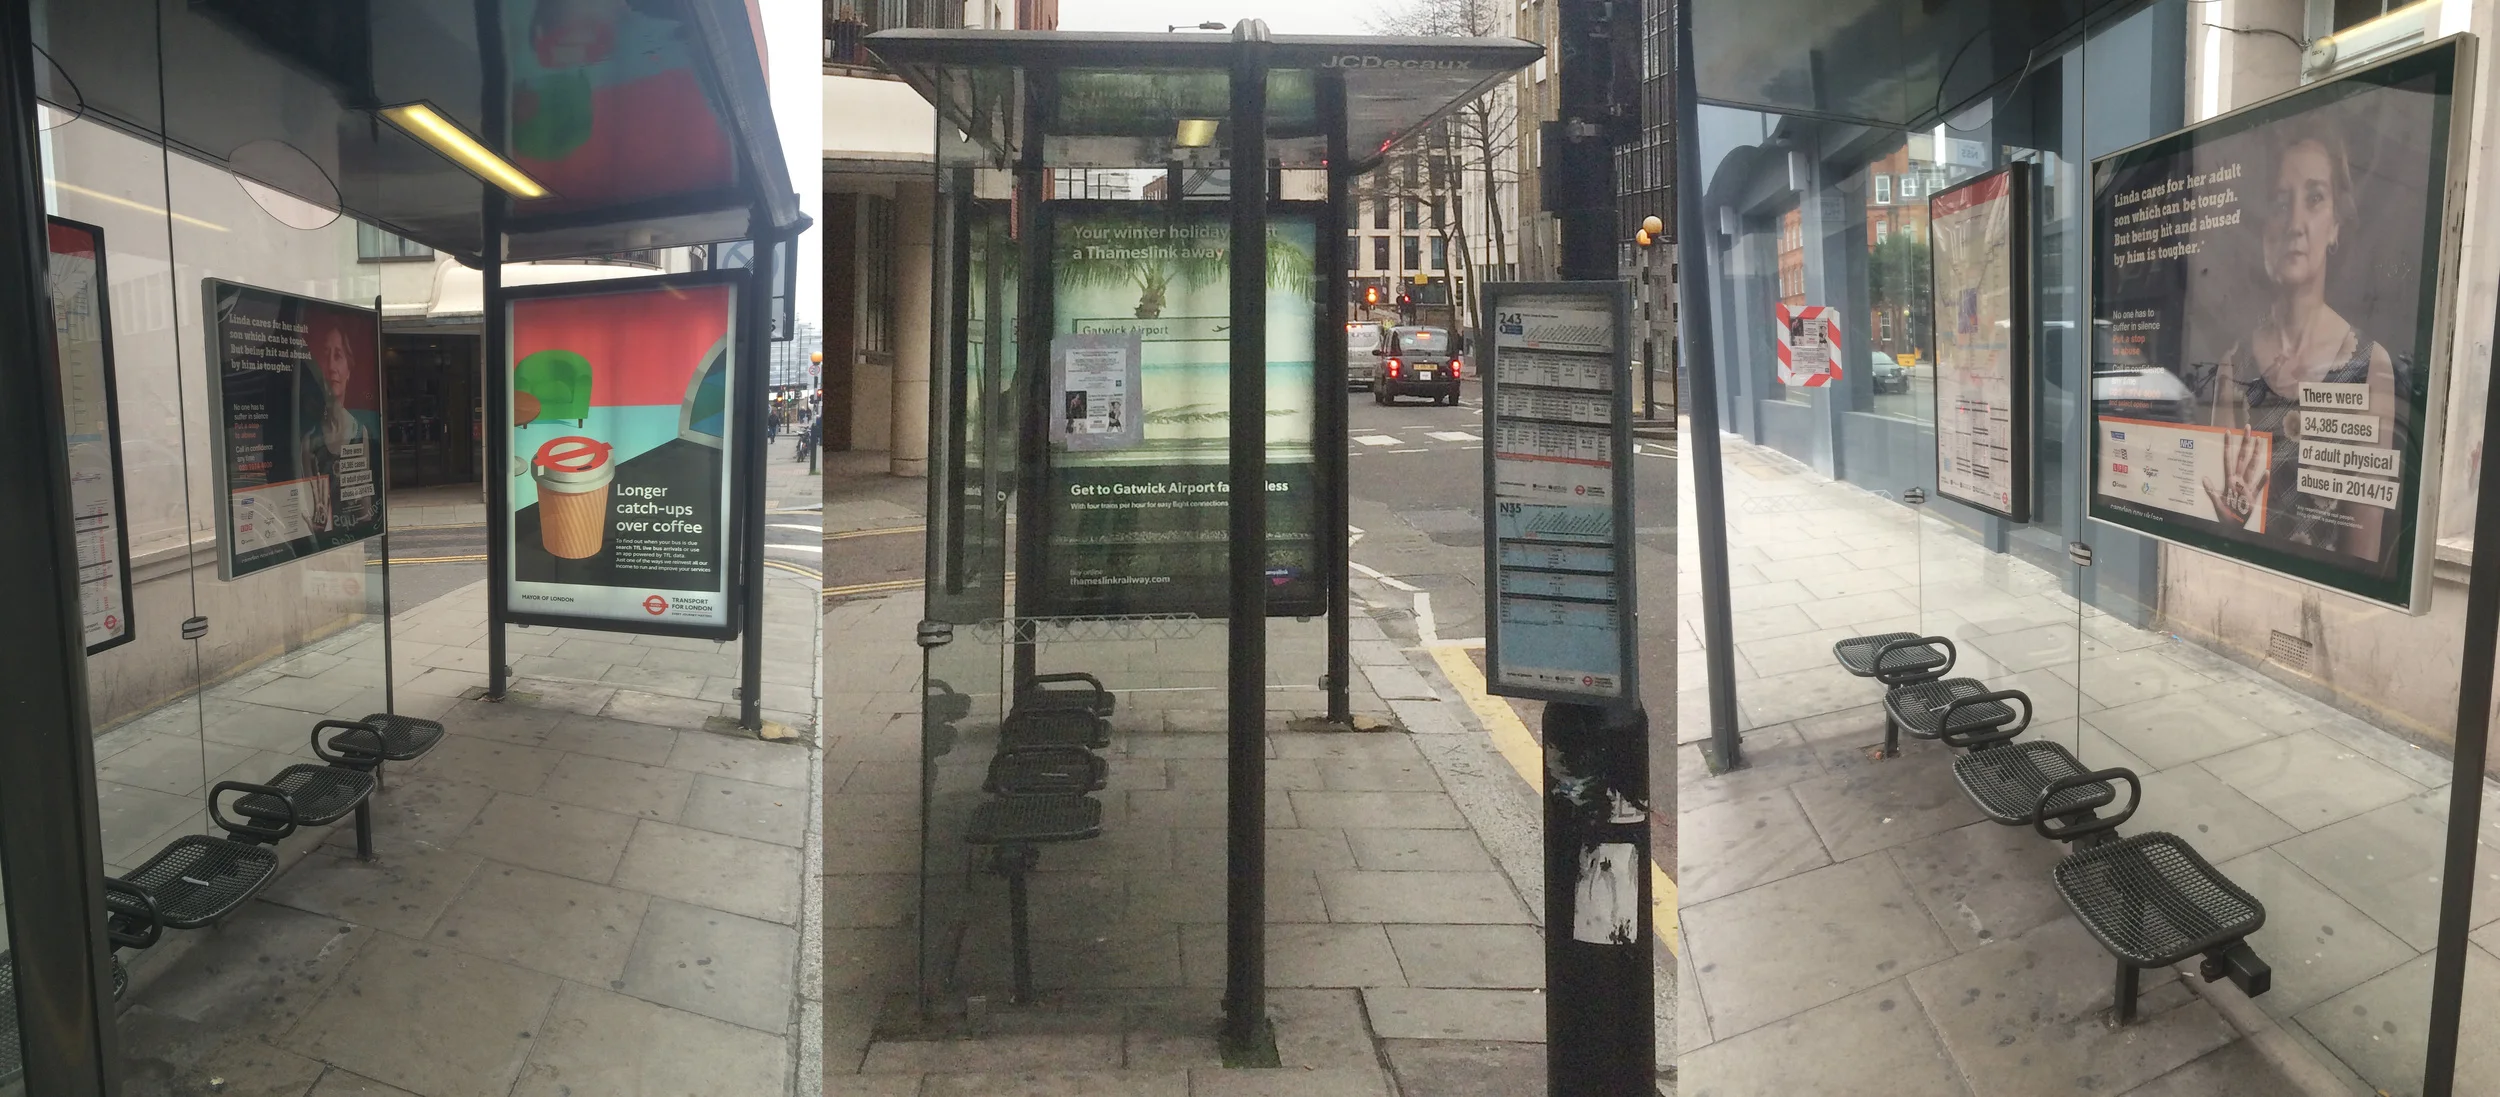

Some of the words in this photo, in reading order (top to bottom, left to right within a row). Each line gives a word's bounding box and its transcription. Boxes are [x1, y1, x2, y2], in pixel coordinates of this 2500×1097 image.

[1321, 55, 1471, 71] JCDecaux
[2114, 190, 2140, 207] Linda
[2141, 184, 2165, 200] cares
[2167, 179, 2185, 193] for
[2187, 174, 2206, 189] her
[2208, 163, 2241, 184] adult
[2114, 216, 2130, 227] son
[2132, 205, 2161, 223] which
[2162, 202, 2180, 216] can
[2183, 198, 2196, 212] be
[2198, 188, 2238, 208] tough.
[1073, 226, 1110, 241] Your
[1114, 225, 1166, 239] winter
[2114, 233, 2130, 246] But
[2132, 228, 2159, 243] being
[2160, 223, 2173, 238] hit
[2174, 218, 2197, 235] and
[2200, 209, 2241, 231] abused
[1072, 250, 1083, 260] a
[1086, 246, 1178, 260] Thameslink
[1181, 248, 1225, 261] away
[2114, 254, 2125, 268] by
[2126, 250, 2145, 264] him
[2147, 247, 2156, 261] is
[1500, 312, 1522, 324] 243
[2112, 310, 2121, 319] No
[2123, 311, 2134, 319] one
[2135, 309, 2146, 318] has
[2147, 308, 2155, 317] to
[229, 313, 251, 326] Linda
[252, 318, 272, 328] cares
[272, 319, 281, 329] for
[282, 320, 292, 331] her
[293, 324, 309, 334] adult
[1082, 325, 1127, 335] Gatwick
[1129, 324, 1169, 336] Airport
[2112, 323, 2130, 332] suffer
[2131, 322, 2137, 330] in
[2137, 321, 2160, 330] silence
[229, 331, 243, 340] son
[244, 331, 266, 342] which
[268, 335, 280, 343] can
[281, 335, 288, 344] be
[2112, 335, 2123, 343] Put
[2131, 334, 2146, 344] stop
[230, 344, 244, 354] But
[245, 345, 264, 358] being
[266, 346, 277, 357] hit
[278, 349, 289, 358] and
[290, 350, 312, 360] abused
[2112, 347, 2119, 355] to
[2121, 347, 2140, 355] abuse
[231, 359, 241, 371] by
[241, 360, 256, 369] him
[257, 360, 263, 370] is
[2112, 364, 2123, 373] Call
[2131, 364, 2165, 374] confidence
[2303, 388, 2332, 403] There
[2335, 392, 2363, 405] were
[233, 403, 240, 411] No
[253, 412, 269, 420] silence
[2305, 417, 2338, 434] 34,385
[2341, 422, 2372, 437] cases
[235, 445, 245, 453] Call
[250, 443, 273, 452] confidence
[2180, 440, 2193, 449] NHS
[2302, 446, 2313, 459] of
[2314, 447, 2341, 463] adult
[2343, 451, 2393, 470] physical
[617, 483, 668, 499] Longer
[1070, 484, 1095, 496] Get
[1097, 485, 1111, 495] to
[1113, 483, 1166, 495] Gatwick
[1168, 482, 1215, 496] Airport
[1265, 481, 1289, 492] less
[2301, 474, 2330, 491] abuse
[2332, 478, 2343, 493] in
[2346, 481, 2394, 502] 2014/15
[1070, 502, 1086, 510] With
[1087, 502, 1101, 510] four
[1131, 501, 1147, 509] hour
[1147, 501, 1157, 509] for
[1172, 501, 1189, 509] flight
[1190, 500, 1229, 508] connections
[1500, 502, 1522, 514] N35
[2227, 488, 2249, 515] NO
[616, 502, 693, 518] catch-ups
[616, 522, 649, 532] over
[652, 520, 703, 534] coffee
[1070, 575, 1171, 587] thameslinkrailway.com
